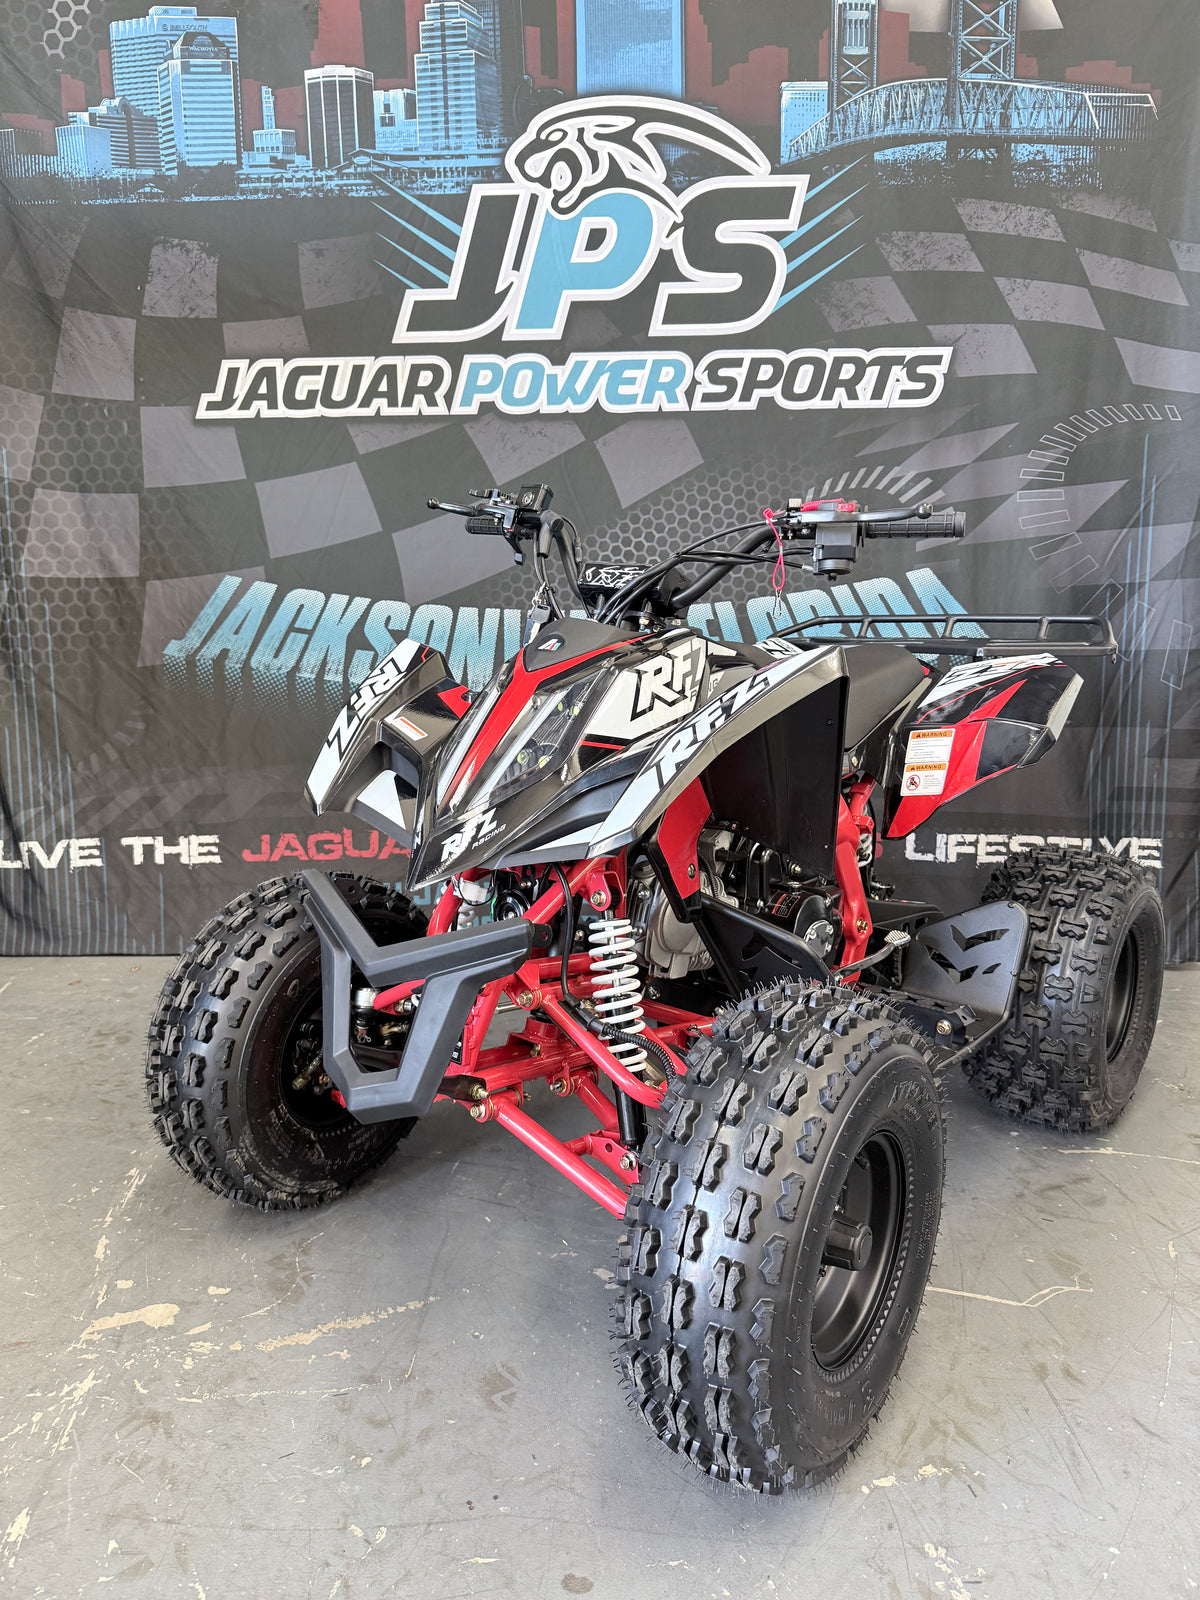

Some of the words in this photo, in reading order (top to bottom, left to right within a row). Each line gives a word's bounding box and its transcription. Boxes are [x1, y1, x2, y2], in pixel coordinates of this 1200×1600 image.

[392, 174, 810, 343] JPS
[197, 356, 449, 417] JAGUAR
[454, 354, 691, 413] POWER
[693, 349, 951, 410] SPORTS
[650, 674, 770, 786] RFZ
[0, 838, 103, 870] LIVE
[120, 834, 223, 866] THE
[242, 828, 410, 863] JAGUA
[471, 824, 507, 850] RACING
